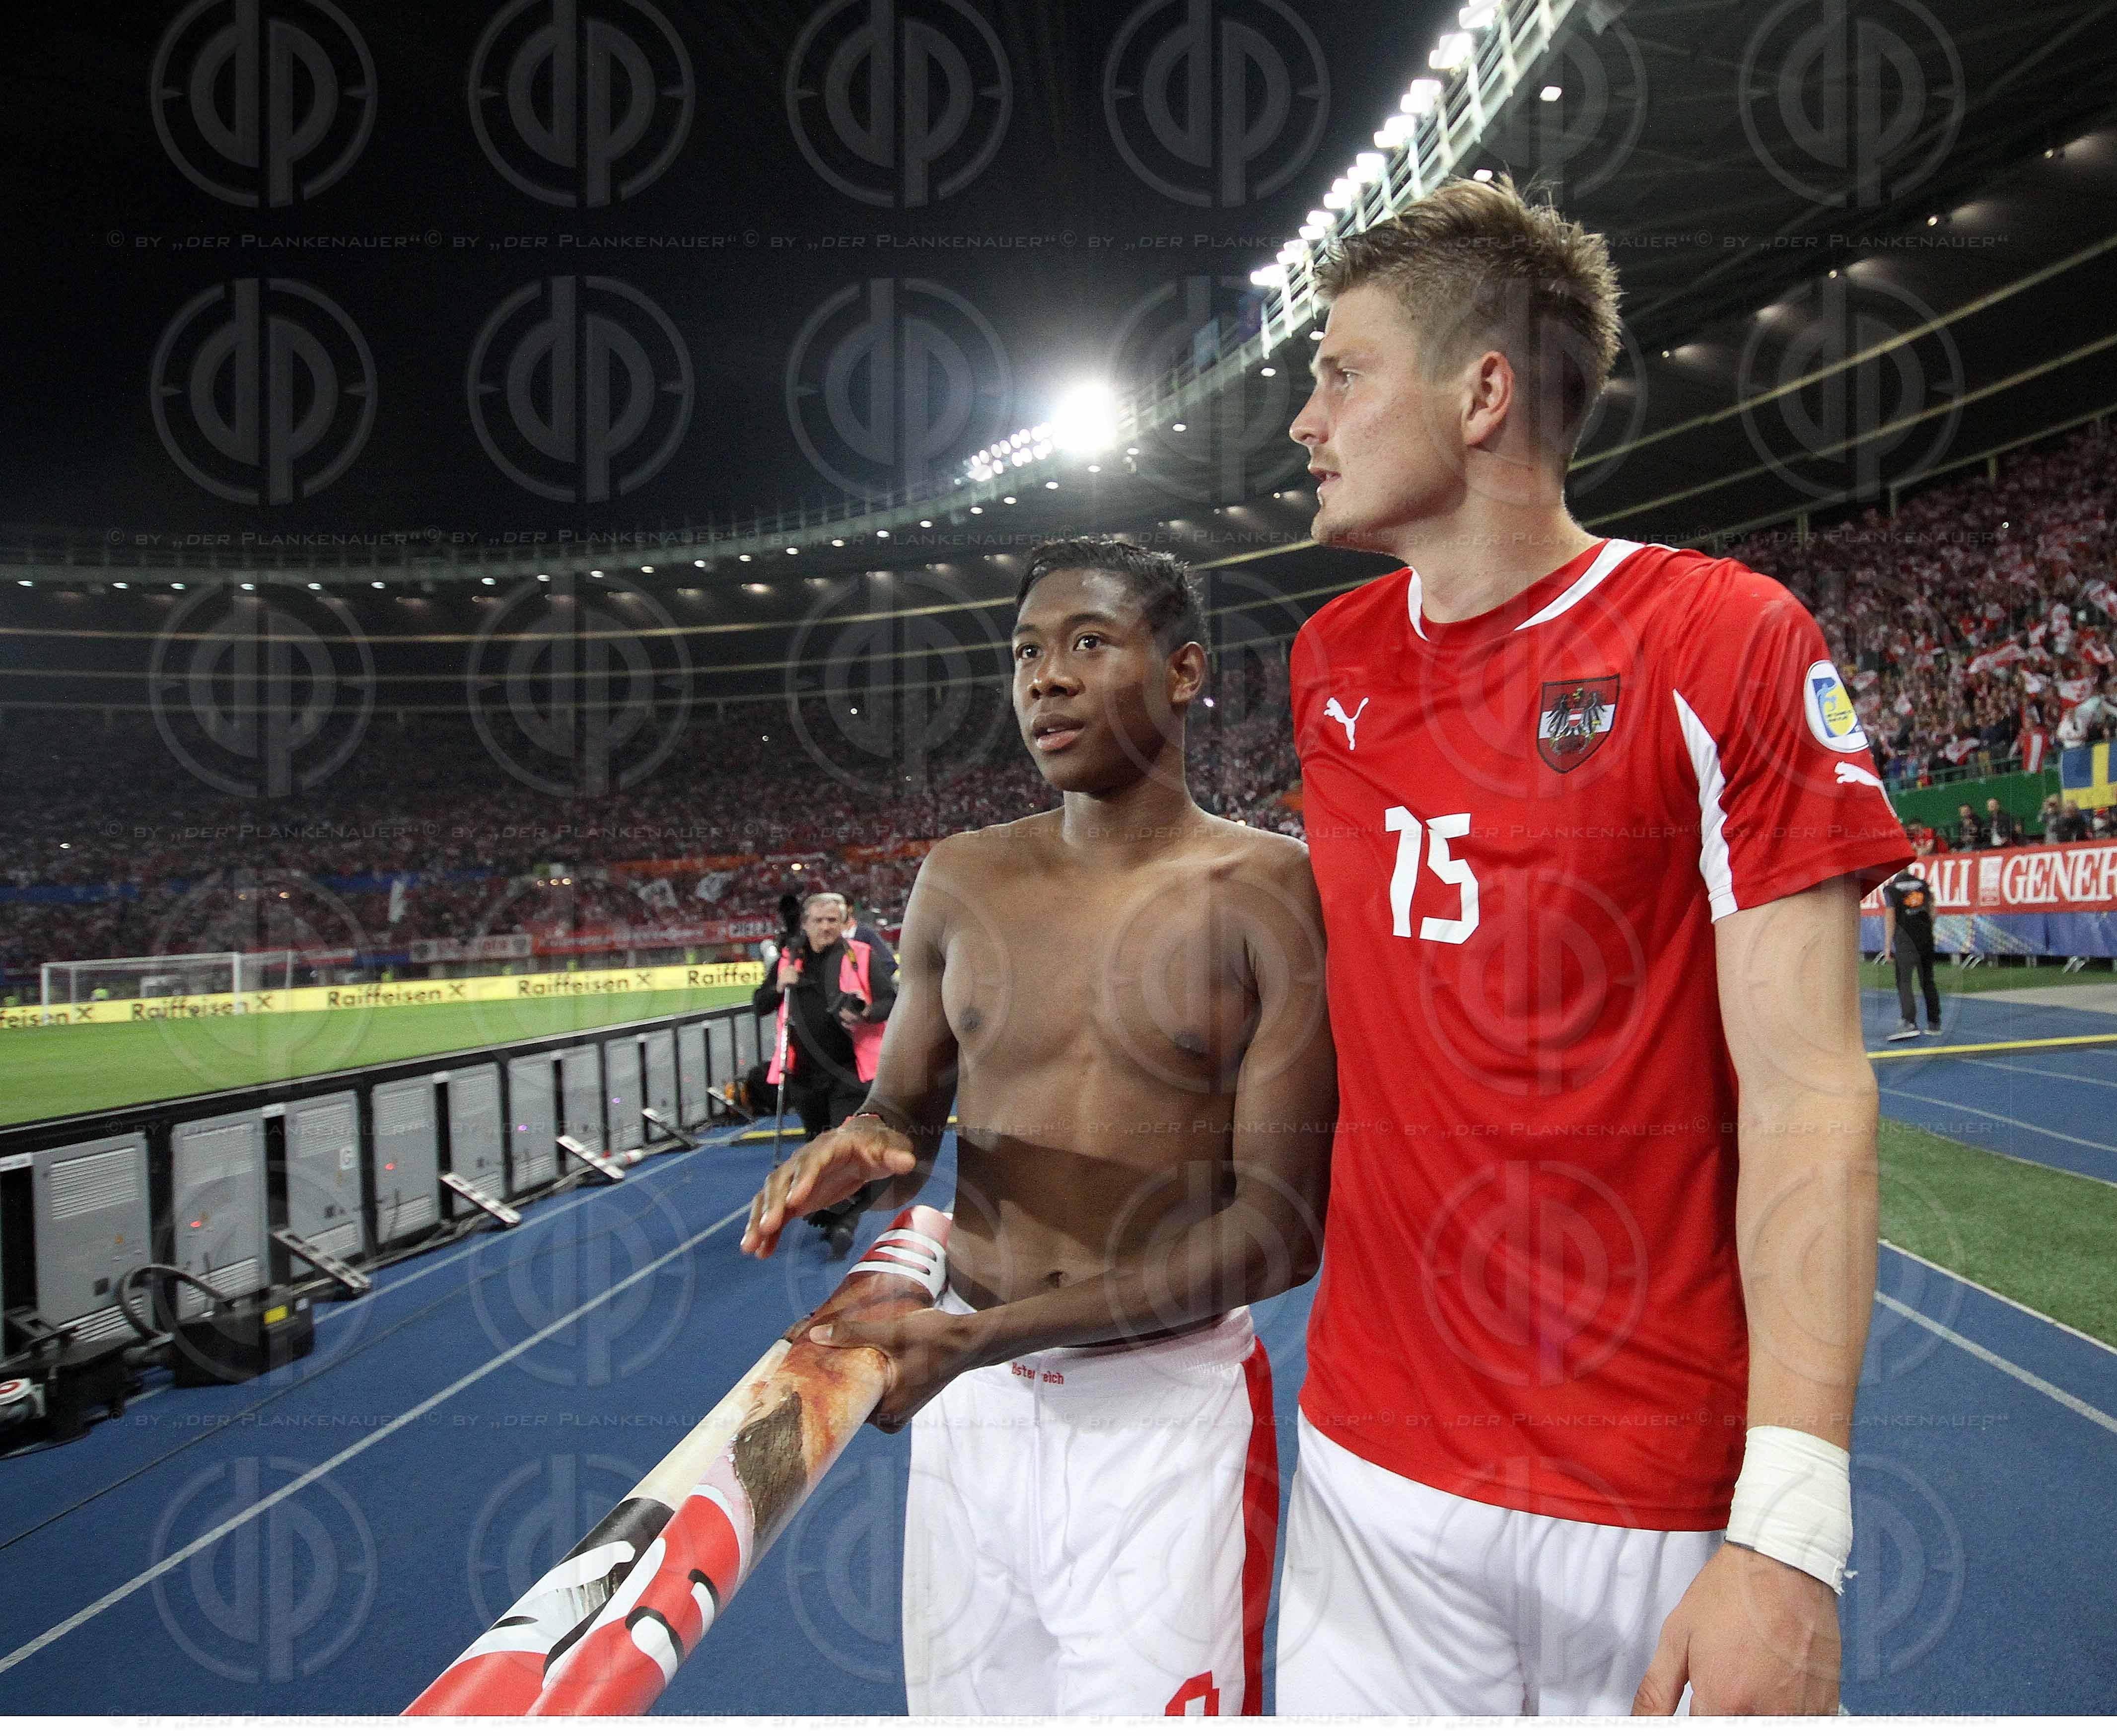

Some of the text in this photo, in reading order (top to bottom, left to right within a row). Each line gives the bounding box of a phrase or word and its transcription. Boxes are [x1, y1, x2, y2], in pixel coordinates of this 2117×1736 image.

[1385, 805, 1480, 944] 15
[328, 984, 442, 1007] Raiffeisen
[519, 973, 629, 995] Raiffeisen
[133, 996, 249, 1020] Raiffeisen
